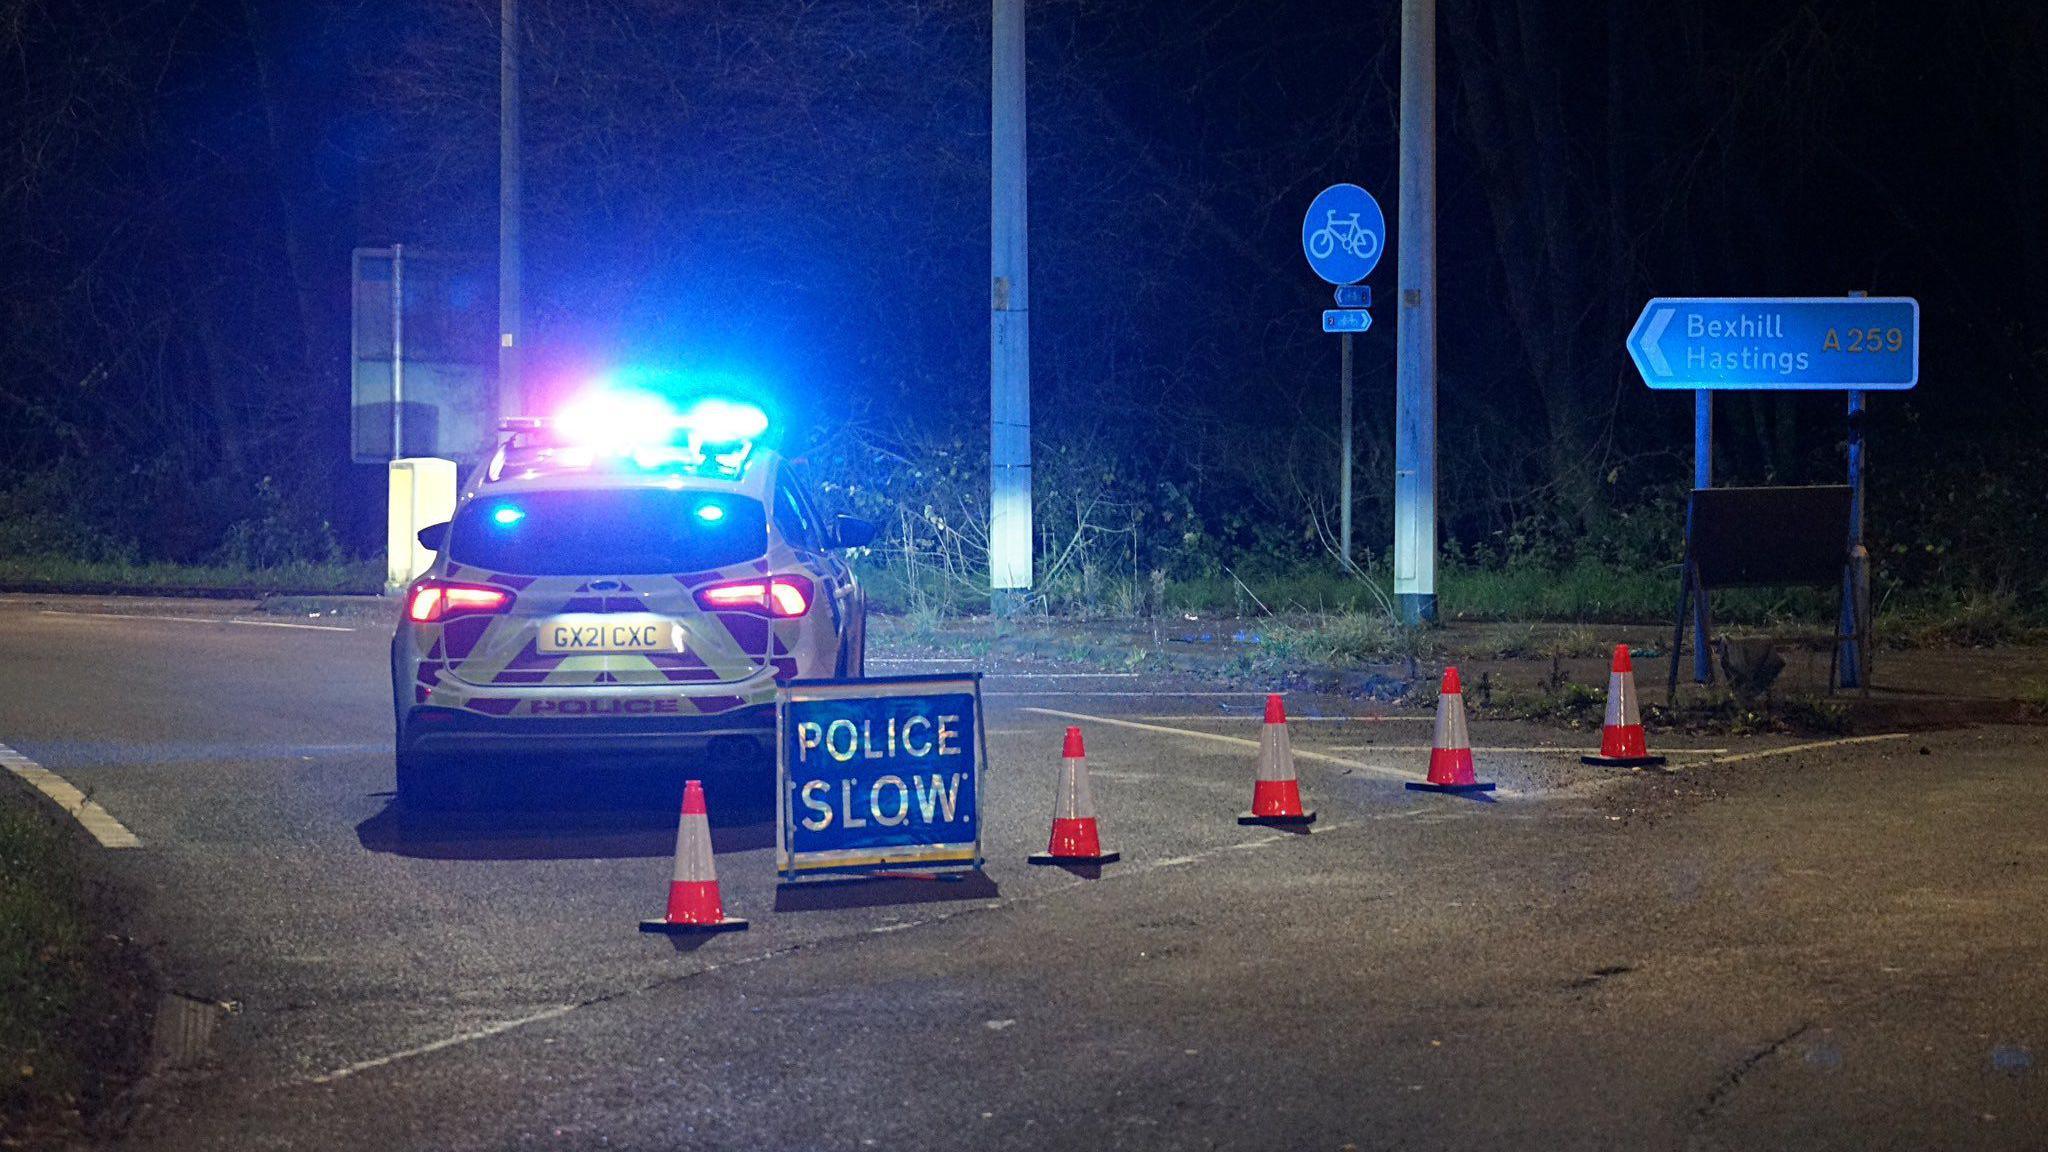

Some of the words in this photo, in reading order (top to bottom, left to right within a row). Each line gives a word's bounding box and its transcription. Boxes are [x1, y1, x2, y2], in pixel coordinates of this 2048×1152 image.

[1688, 315, 1783, 338] Bexhill
[1687, 347, 1809, 374] Hastings
[554, 627, 605, 647] GX21
[613, 626, 657, 646] CXC
[530, 698, 679, 714] POLICE
[798, 715, 961, 762] POLICE
[801, 773, 960, 832] SLOW
